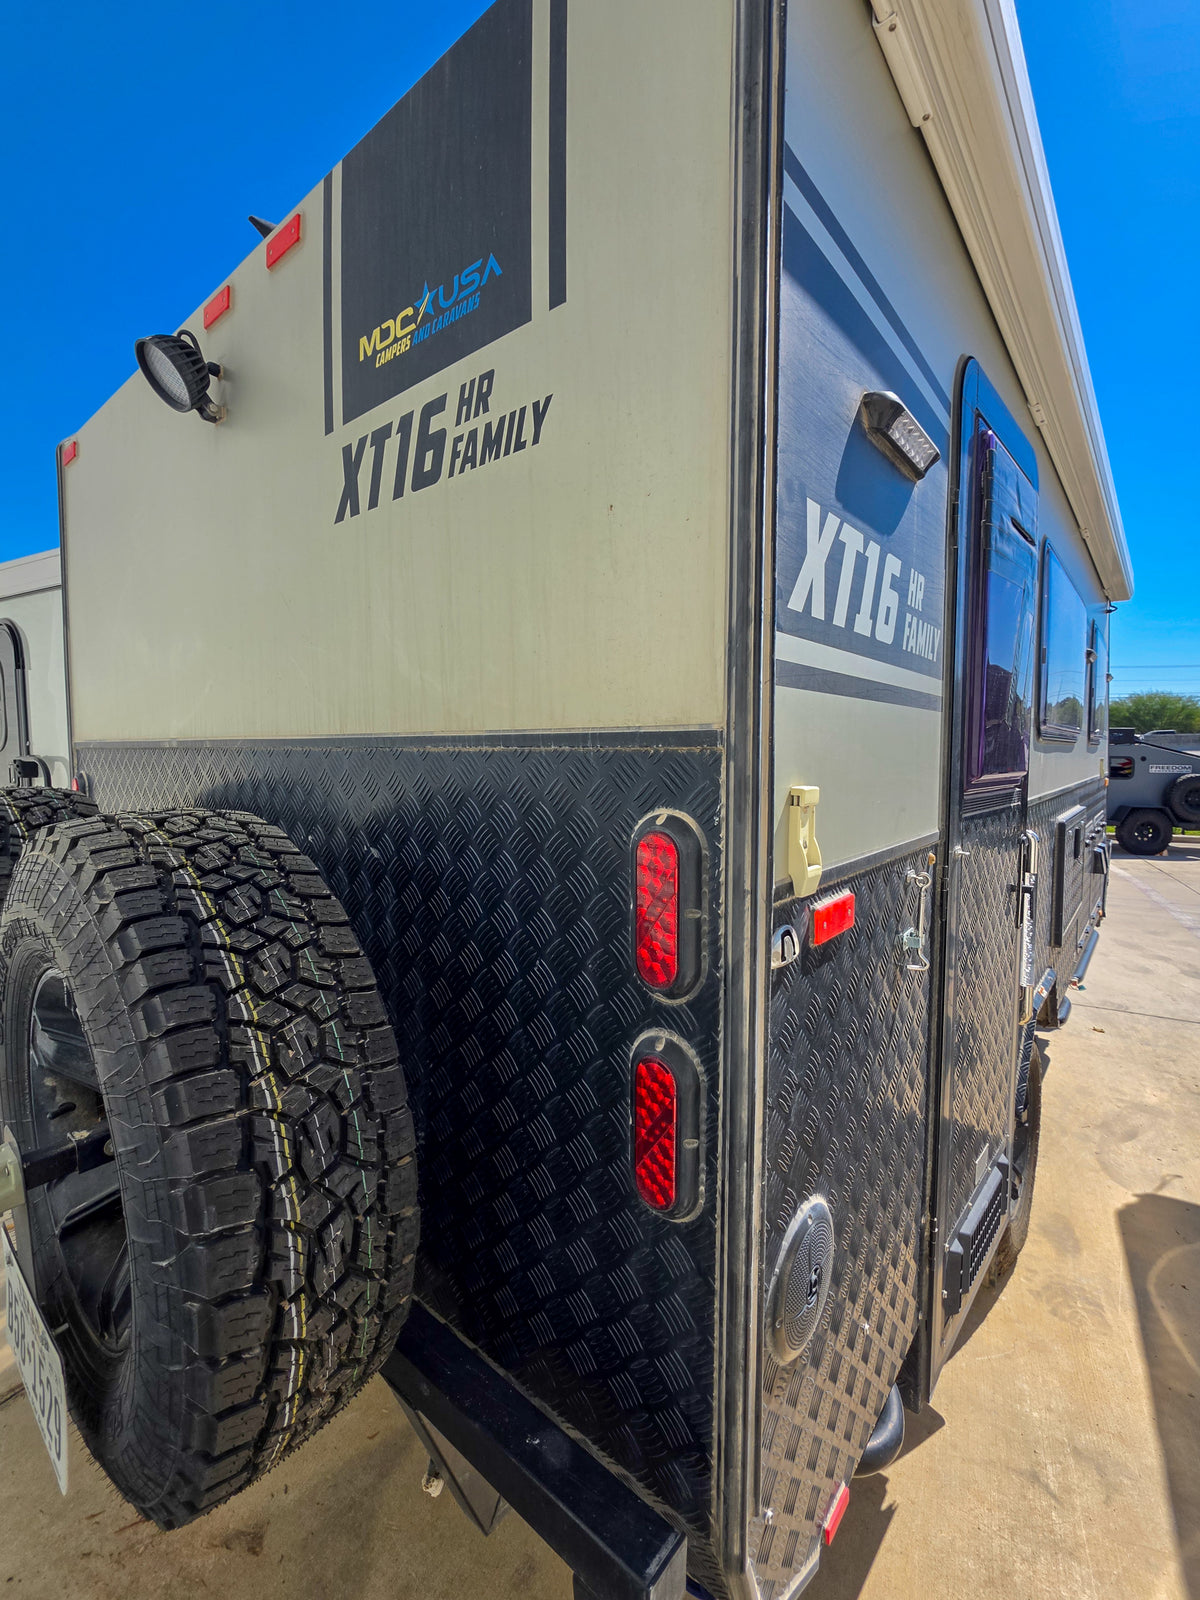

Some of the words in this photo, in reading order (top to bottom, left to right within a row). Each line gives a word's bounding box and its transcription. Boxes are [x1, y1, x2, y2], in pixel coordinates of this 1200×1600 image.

[360, 306, 416, 361] MDC
[438, 252, 502, 308] USA
[376, 335, 411, 368] CAMPERS
[412, 323, 430, 346] AND
[432, 291, 480, 334] CARAVANS
[334, 392, 448, 524] XT16
[455, 368, 495, 427] HR
[448, 393, 553, 479] FAMILY
[787, 497, 902, 645] XT16
[908, 568, 925, 612] HR
[902, 613, 941, 662] FAMILY
